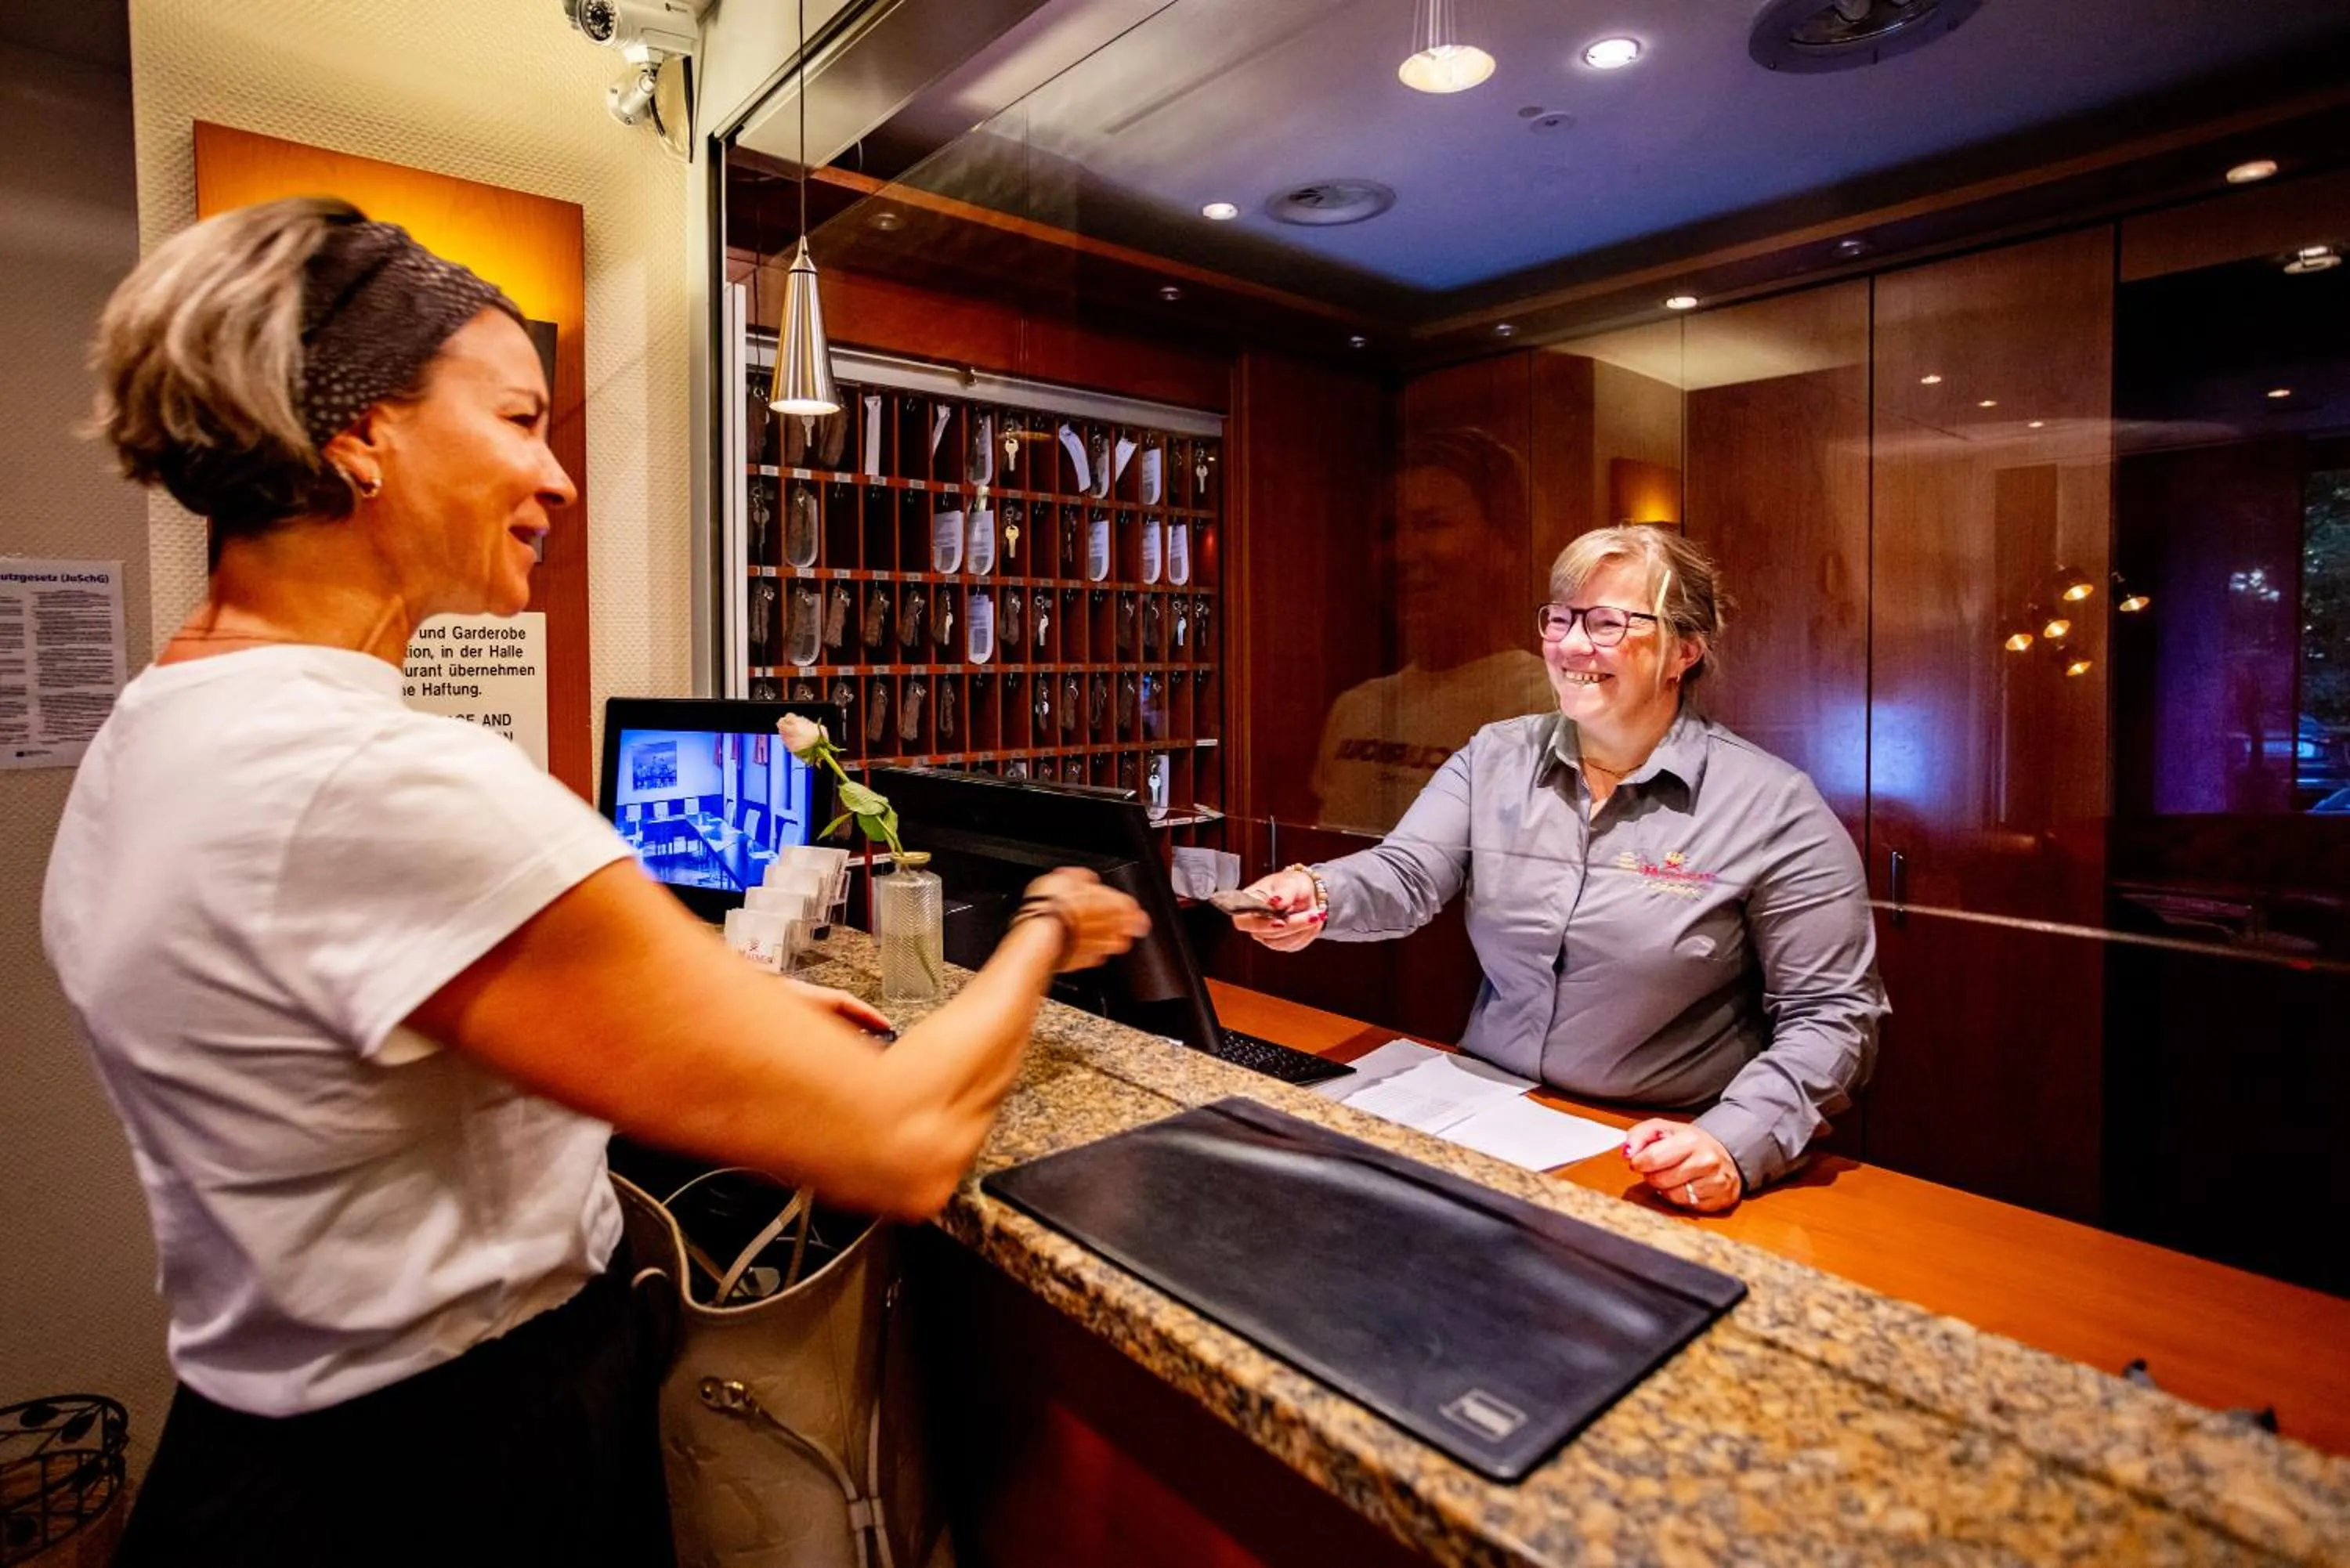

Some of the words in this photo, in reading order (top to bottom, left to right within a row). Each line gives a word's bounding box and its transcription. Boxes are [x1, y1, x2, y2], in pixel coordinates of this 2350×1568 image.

[0, 573, 57, 583] utzgesetz
[60, 574, 109, 583] (JuSchG)
[419, 626, 446, 640] und
[452, 626, 526, 640] Garderobe
[406, 645, 434, 660] ion,
[441, 645, 454, 659] in
[460, 645, 483, 659] der
[490, 645, 524, 659] Halle
[405, 664, 443, 677] urant
[449, 664, 536, 677] übernehmen
[422, 682, 483, 698] Haftung.
[483, 714, 512, 728] AND
